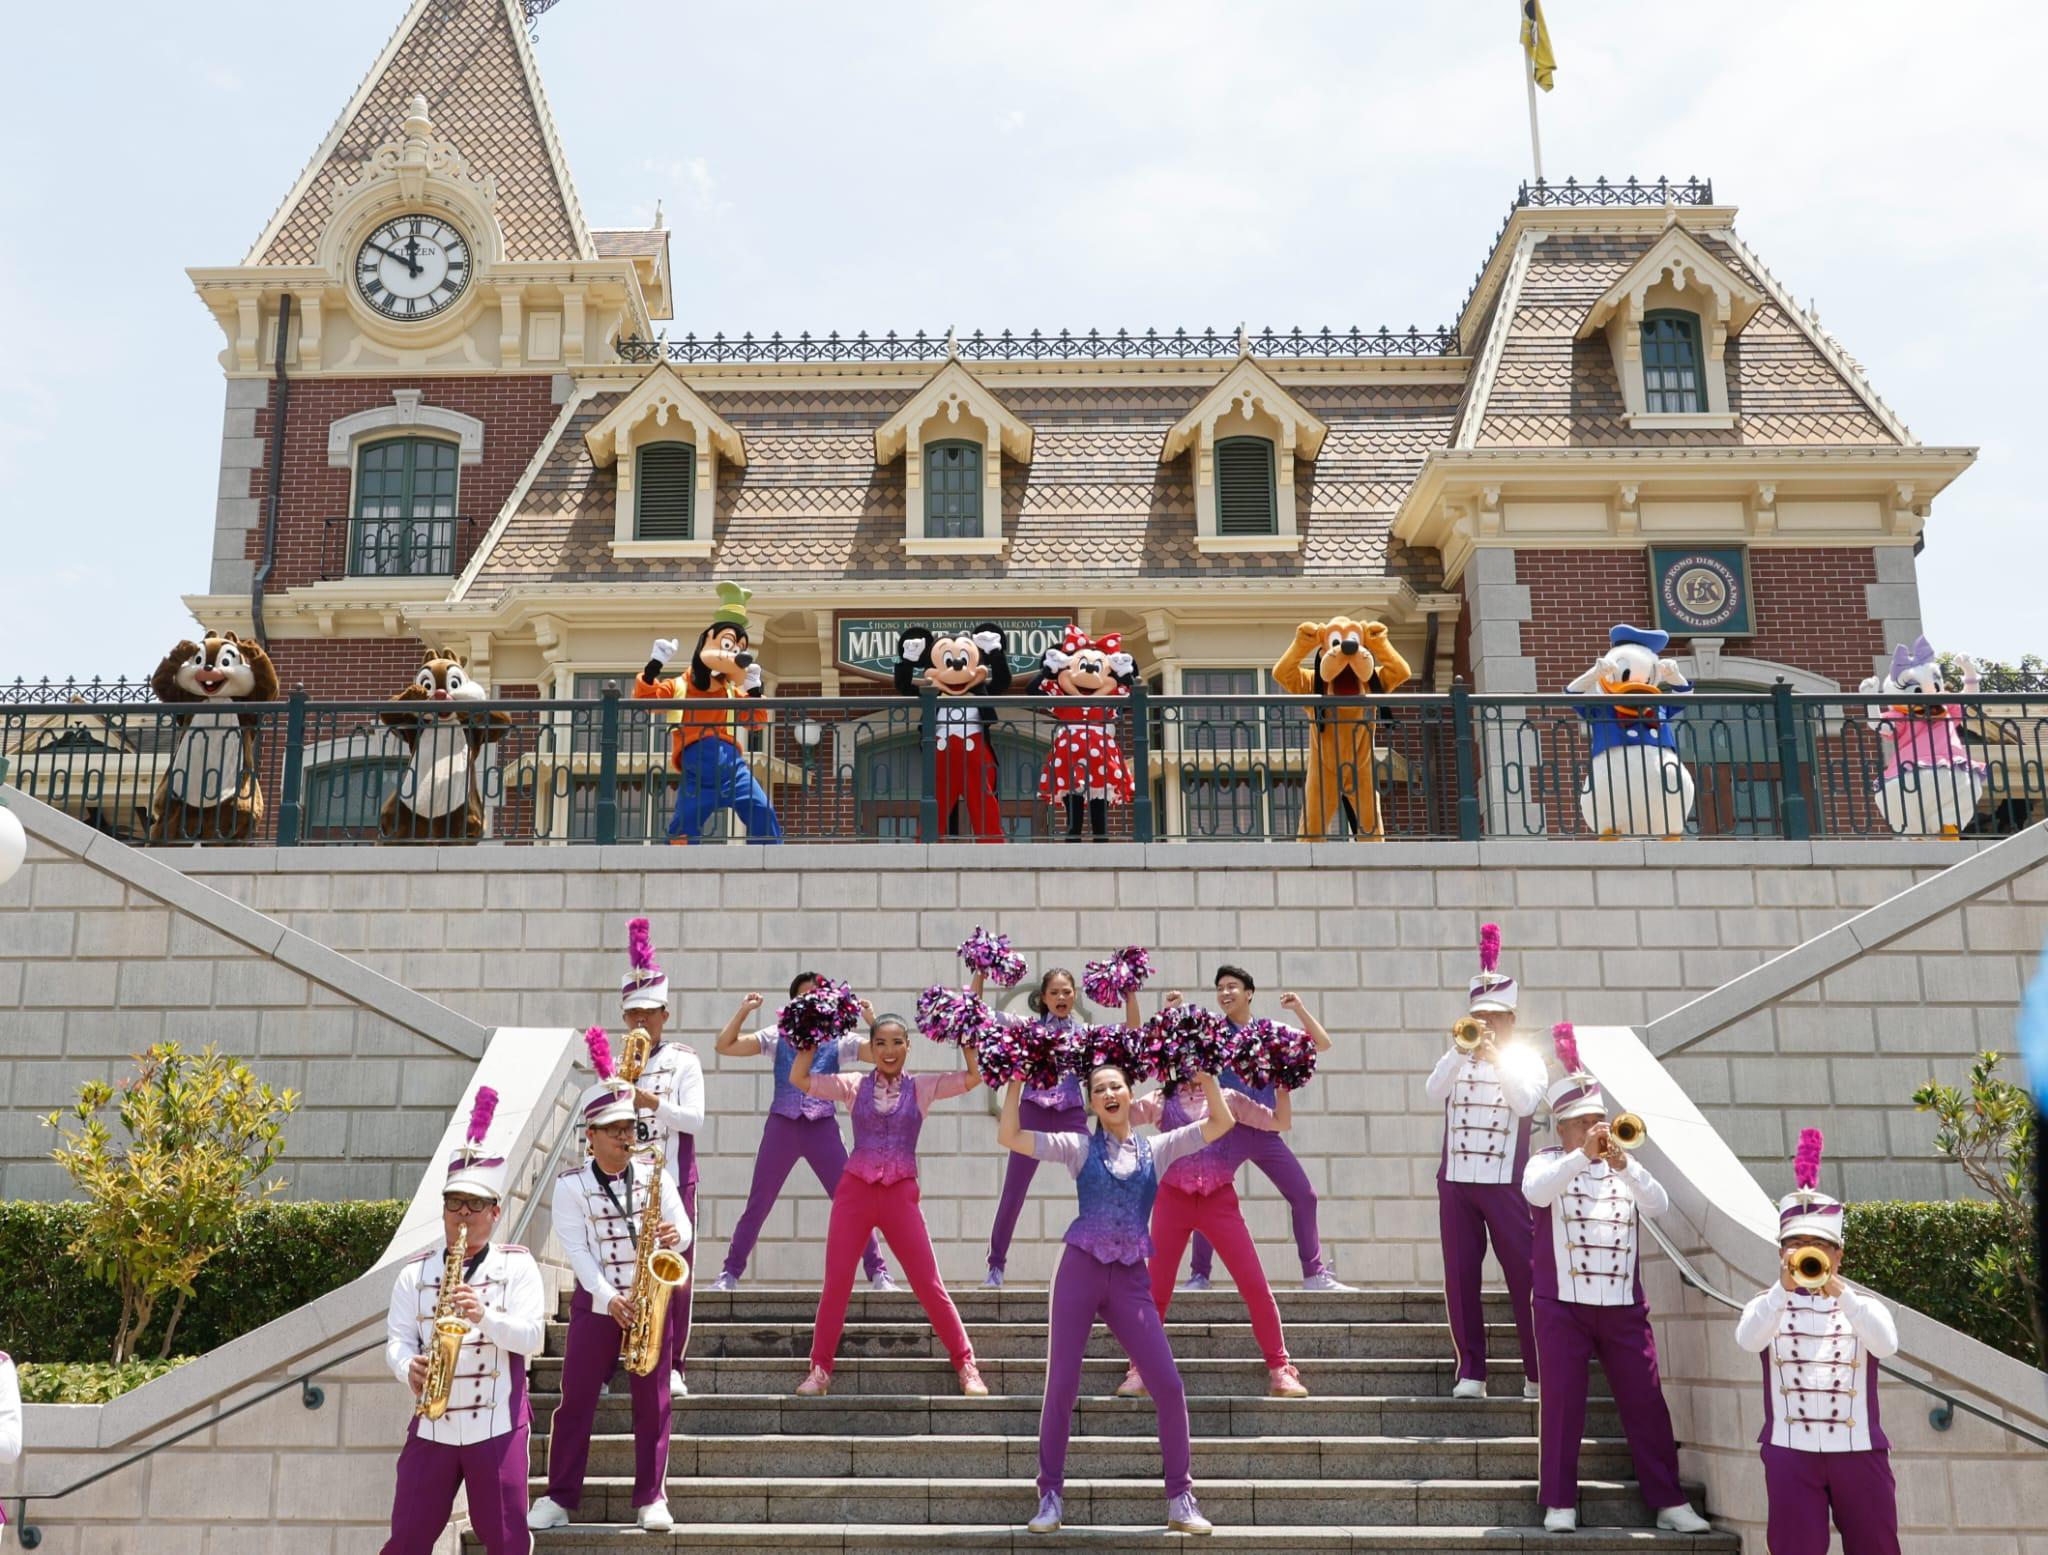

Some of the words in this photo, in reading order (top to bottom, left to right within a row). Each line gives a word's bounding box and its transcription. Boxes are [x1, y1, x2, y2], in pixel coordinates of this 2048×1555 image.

[409, 221, 421, 234] XII
[393, 247, 436, 257] CITZEN
[874, 621, 900, 630] HONG
[932, 620, 984, 629] DISNEYLAN
